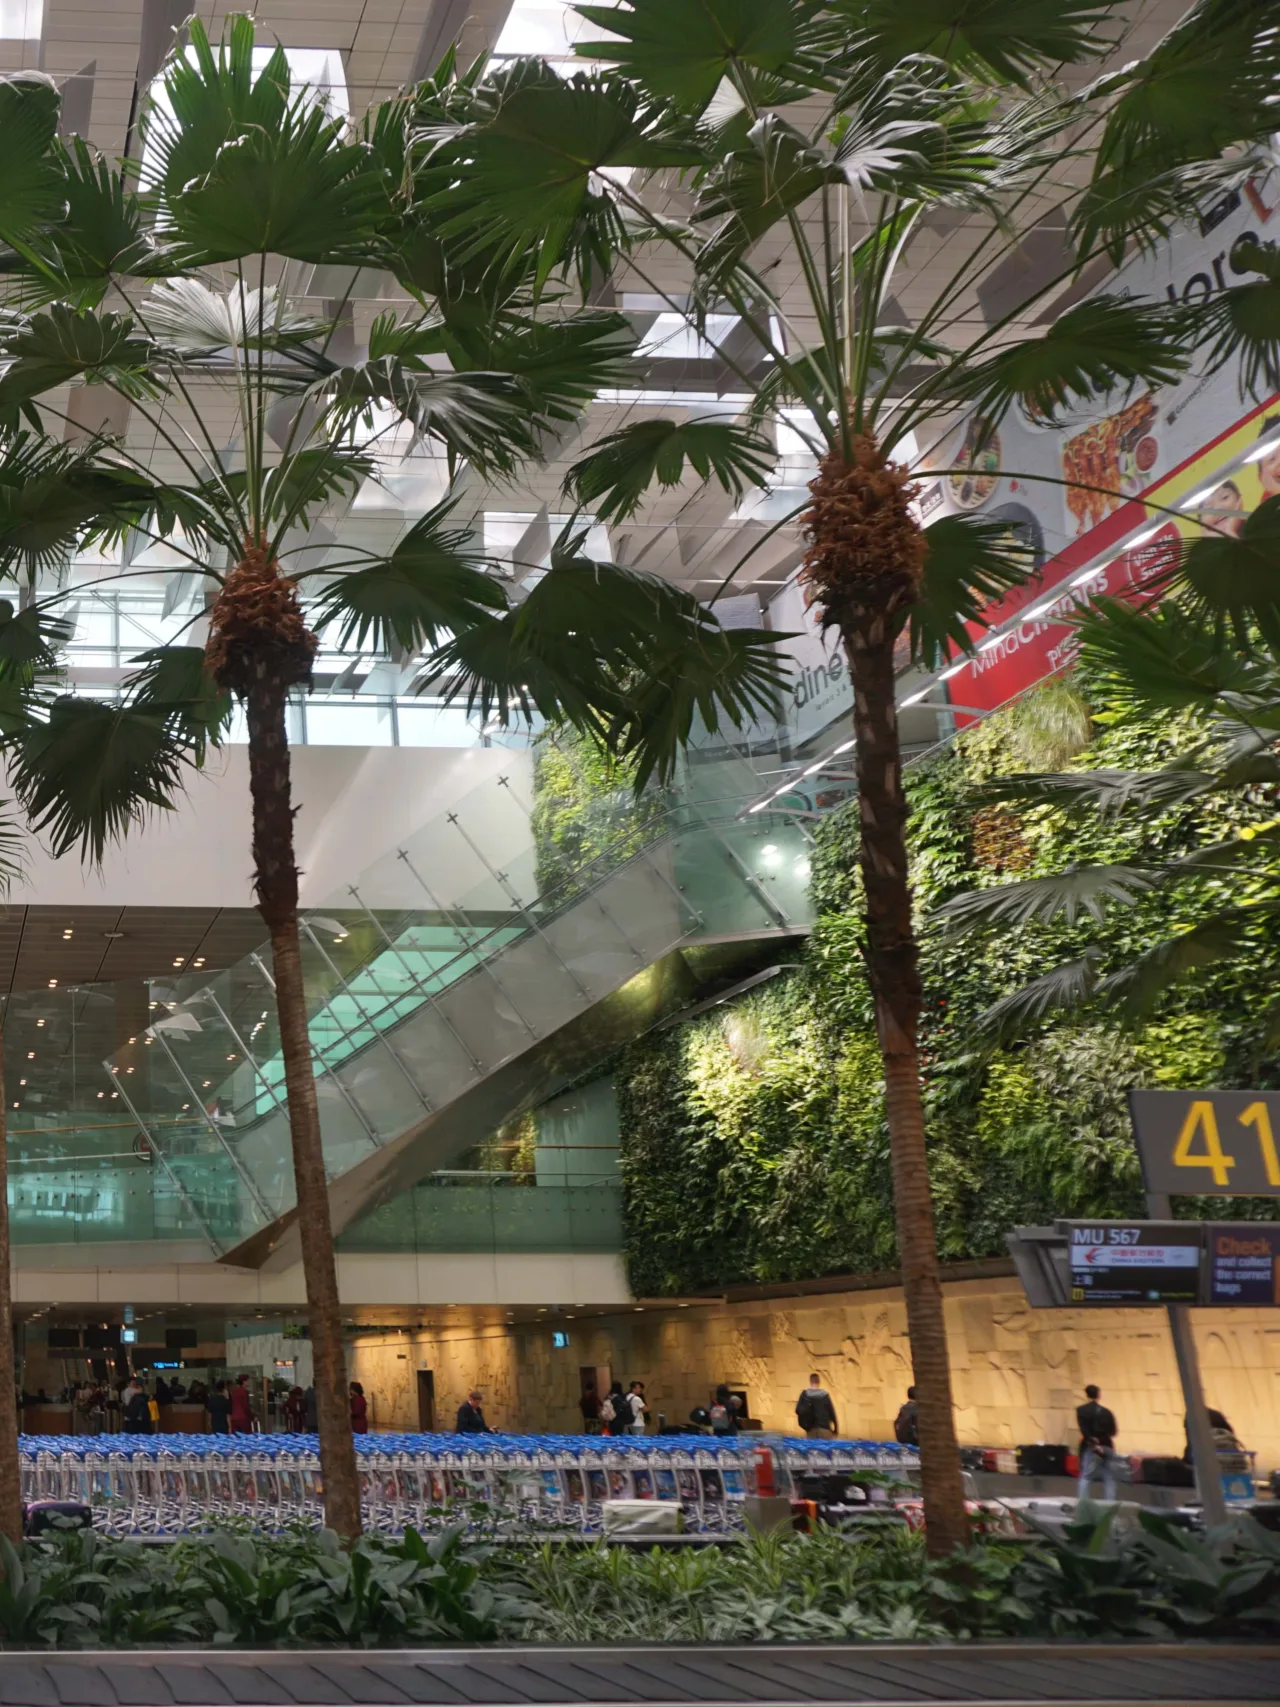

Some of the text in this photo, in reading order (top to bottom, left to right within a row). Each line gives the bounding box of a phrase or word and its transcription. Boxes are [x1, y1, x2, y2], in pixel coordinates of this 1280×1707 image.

[1173, 1100, 1280, 1186] 41
[1073, 1229, 1141, 1244] MU 567
